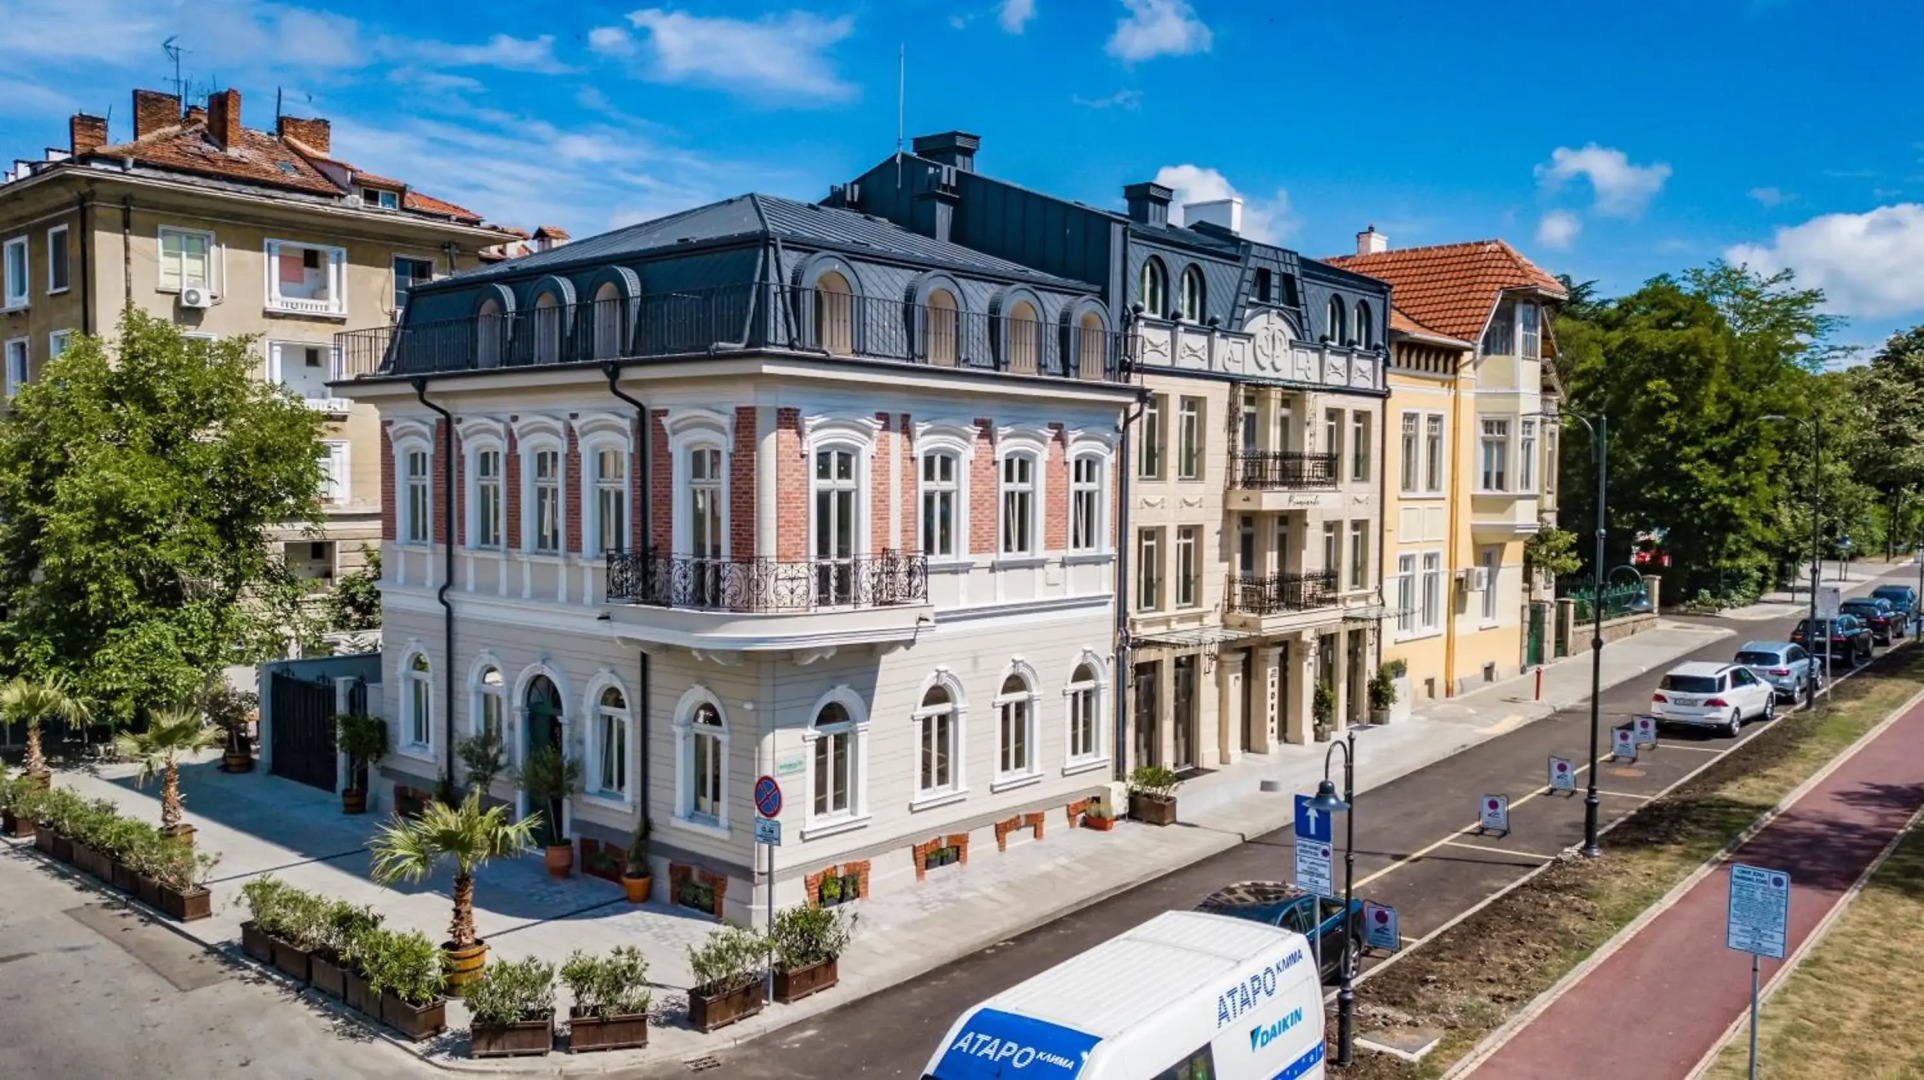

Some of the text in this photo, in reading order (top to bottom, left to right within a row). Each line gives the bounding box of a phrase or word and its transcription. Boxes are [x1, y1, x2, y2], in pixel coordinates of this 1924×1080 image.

[1217, 966, 1276, 1029] АТАРО
[1260, 1006, 1303, 1048] DAIKIN
[951, 1031, 1075, 1071] АТАРО КЛИМА
